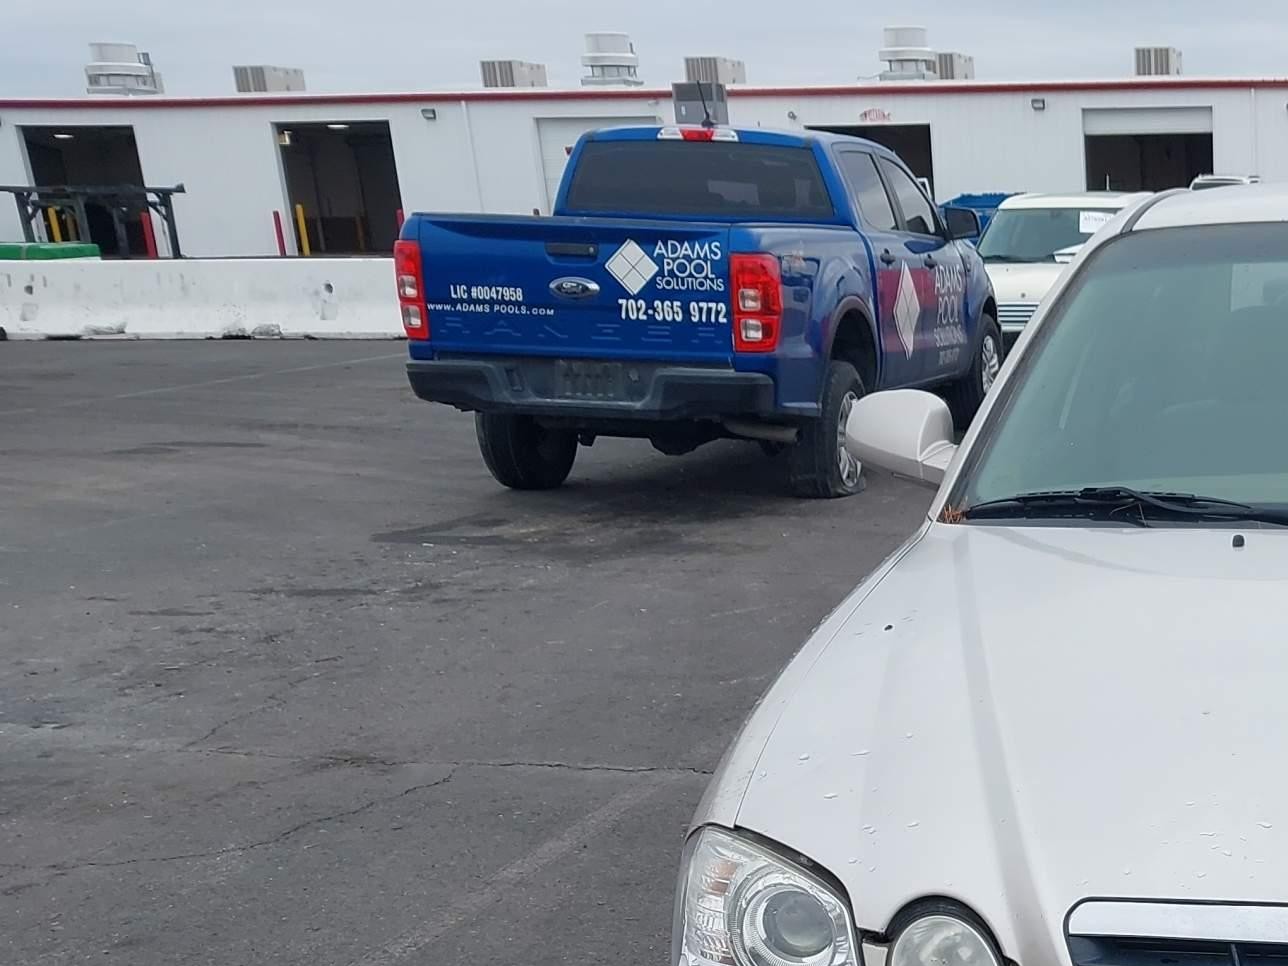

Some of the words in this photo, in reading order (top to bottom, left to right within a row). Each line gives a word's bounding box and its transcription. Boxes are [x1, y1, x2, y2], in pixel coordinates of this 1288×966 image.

[653, 240, 722, 261] ADAMS
[663, 259, 716, 278] POOL
[450, 284, 468, 299] LIC
[471, 286, 523, 301] #0047958
[655, 276, 725, 292] SOLUTIONS
[618, 298, 683, 321] 702-365
[689, 301, 728, 323] 9772
